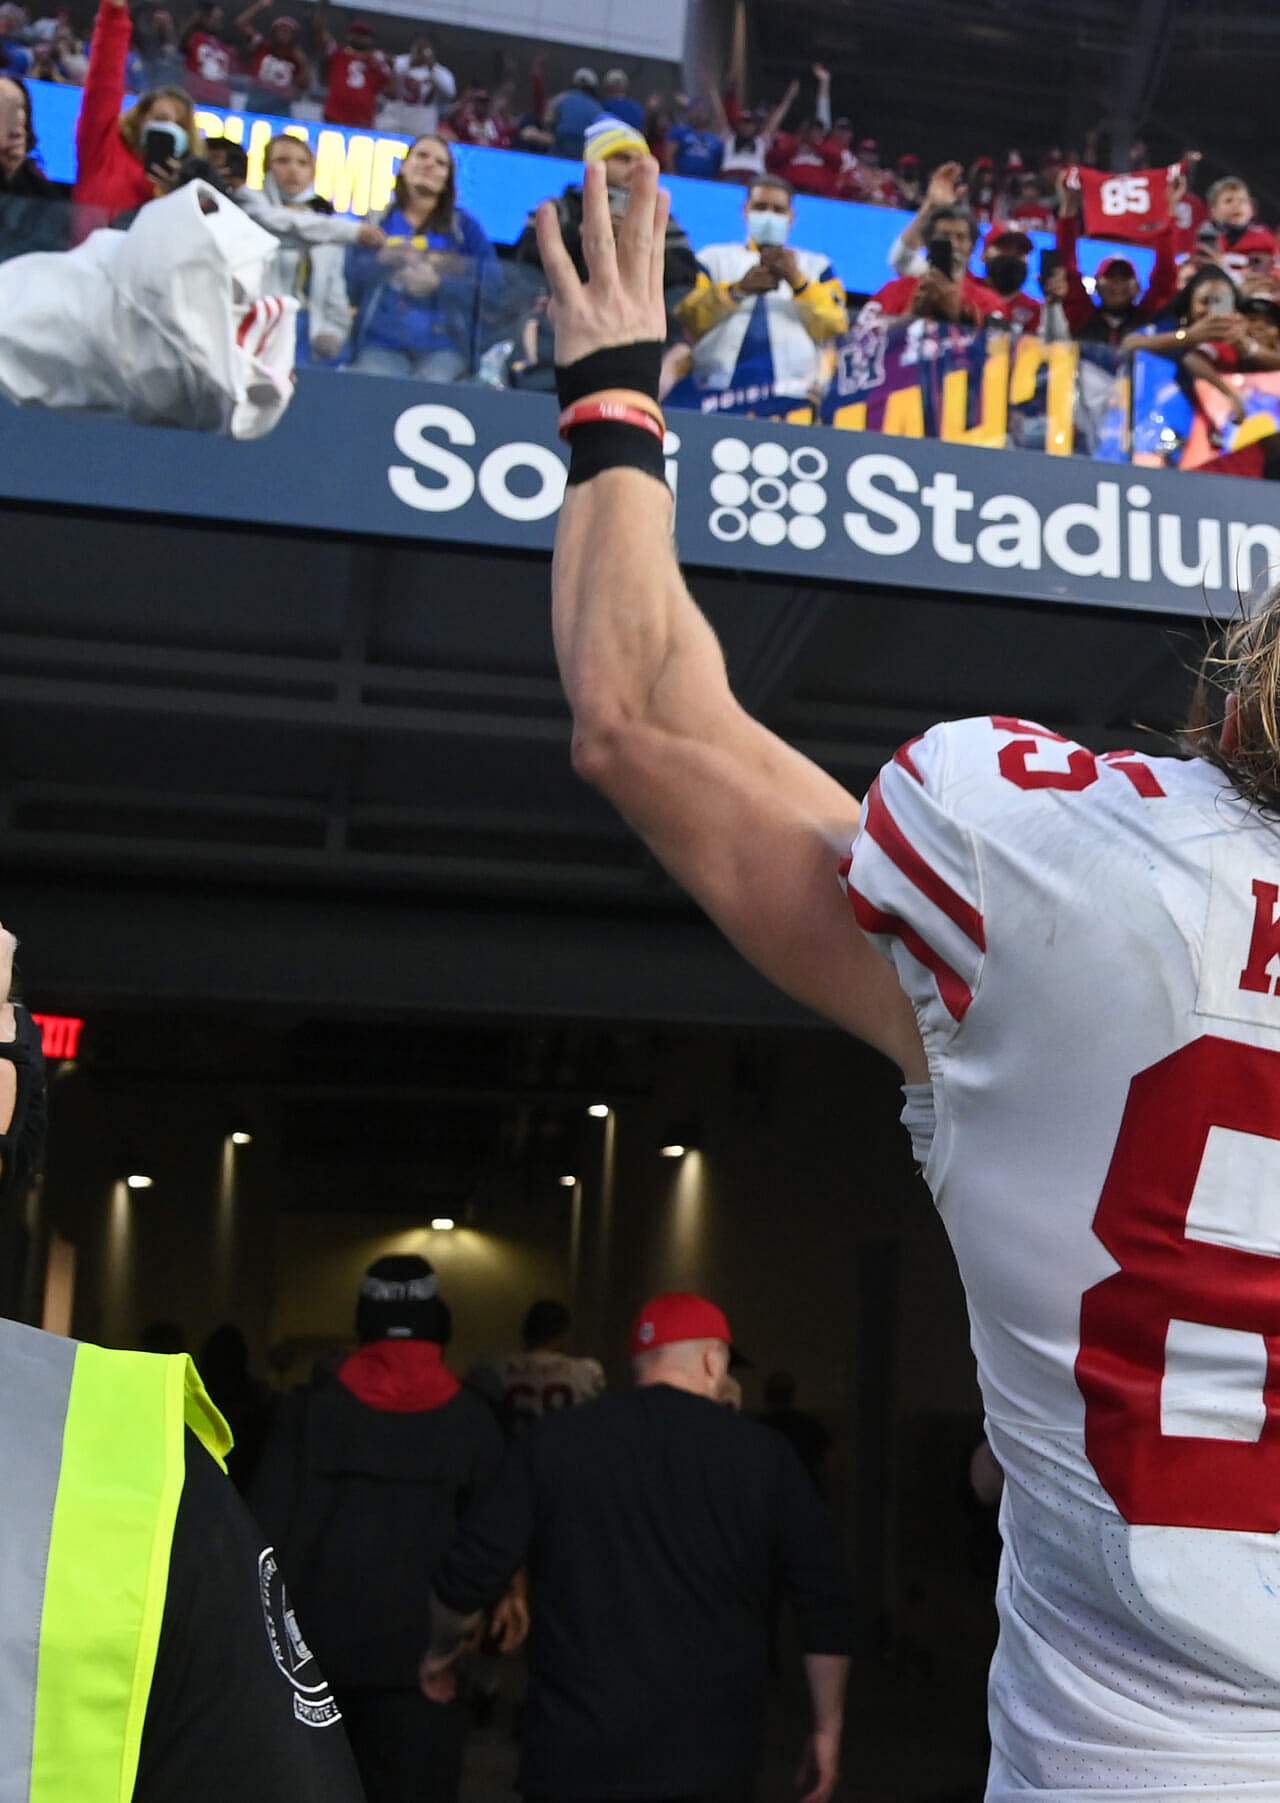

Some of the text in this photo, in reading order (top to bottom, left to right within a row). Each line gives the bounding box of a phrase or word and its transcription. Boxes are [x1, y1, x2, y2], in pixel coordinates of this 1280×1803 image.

[1101, 176, 1151, 216] 85
[388, 403, 680, 523] Soi
[31, 1013, 84, 1060] XIT
